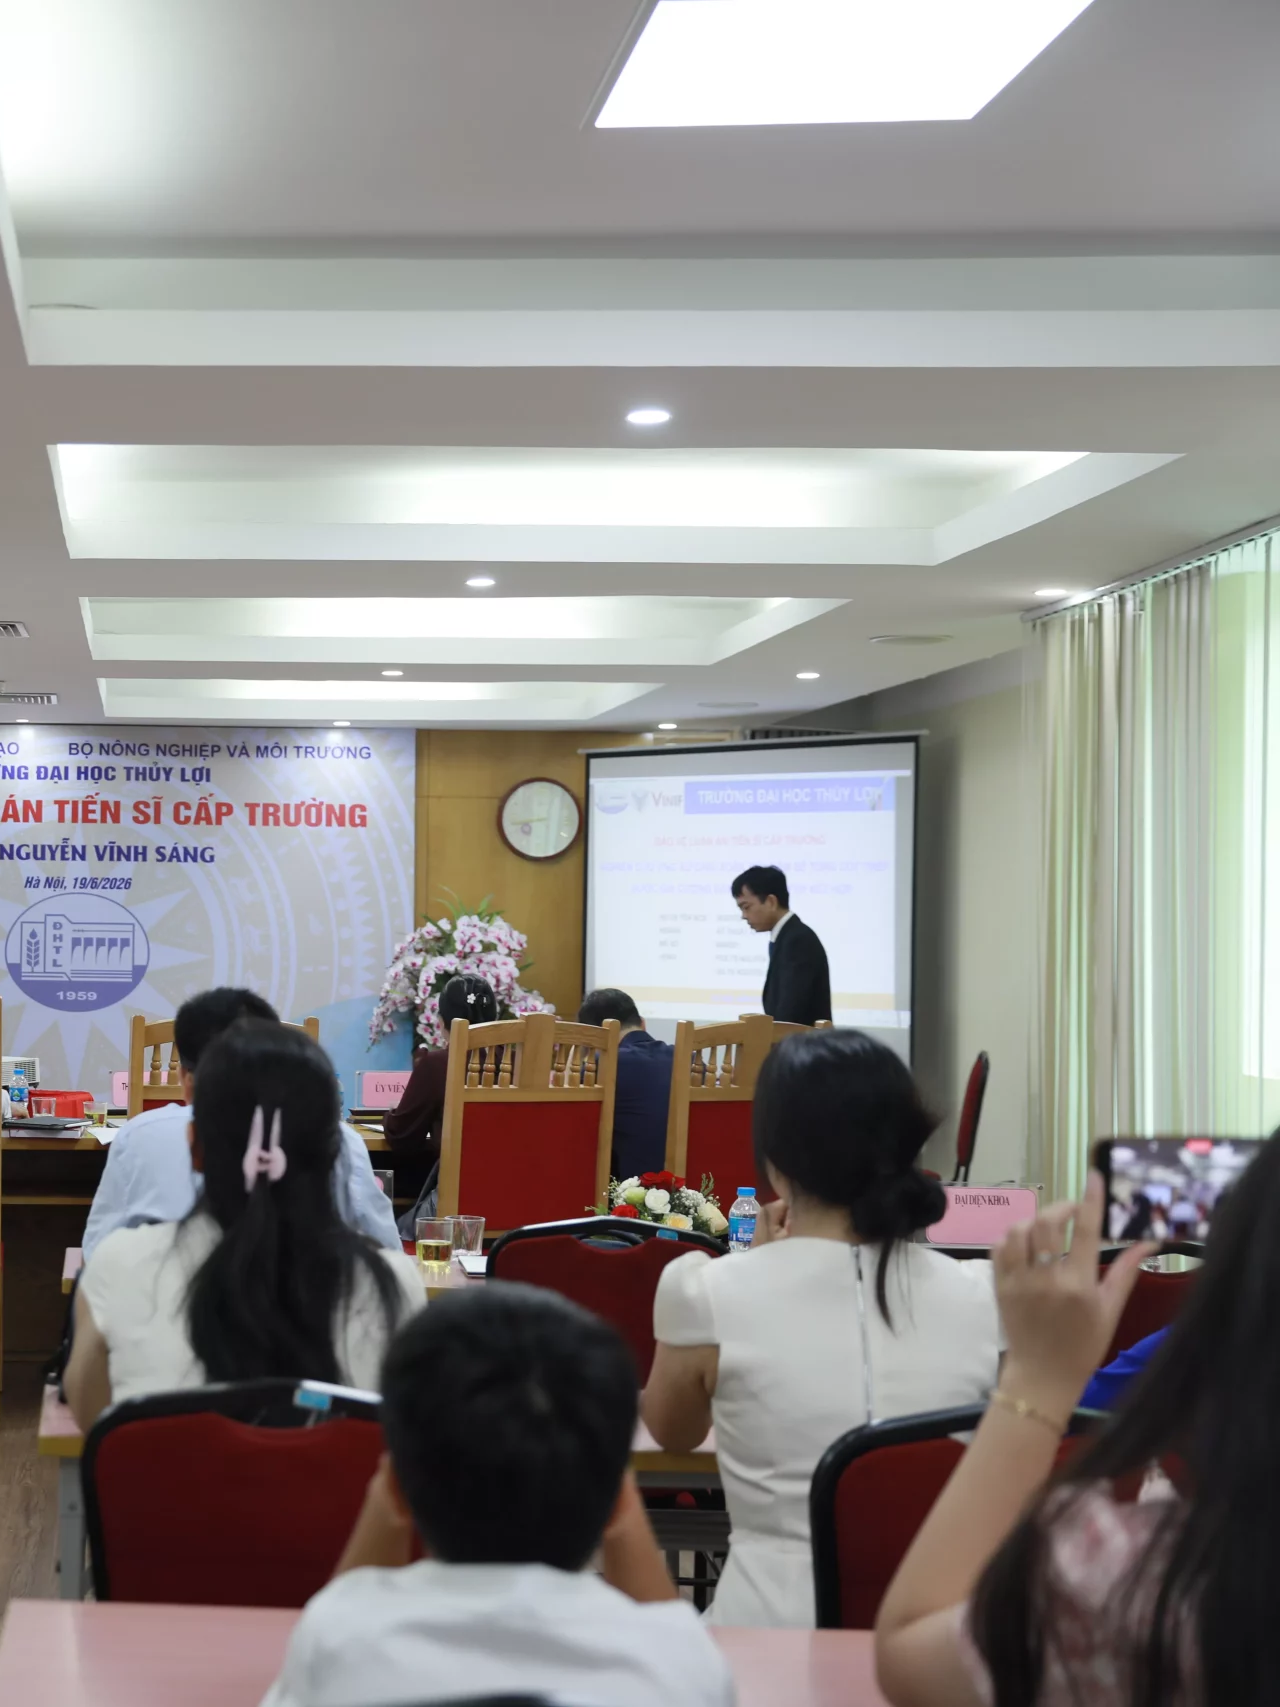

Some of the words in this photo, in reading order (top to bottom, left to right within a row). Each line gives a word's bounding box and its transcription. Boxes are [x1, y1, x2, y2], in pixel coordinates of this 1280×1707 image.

[68, 741, 93, 760] BỘ
[99, 740, 150, 757] NÔNG
[155, 742, 221, 761] NGHIỆP
[226, 741, 250, 758] VÀ
[256, 742, 288, 759] MÔI
[295, 744, 372, 760] TRƯỜNG
[35, 765, 69, 784] ĐẠI
[76, 765, 116, 784] HỌC
[123, 761, 175, 782] THỦY
[180, 766, 211, 786] LỢI
[697, 787, 753, 804] TRƯỜNG
[756, 788, 780, 805] ĐẠI
[782, 787, 812, 804] HỌC
[0, 794, 43, 823] ÁN
[54, 792, 121, 824] TIẾN
[132, 796, 162, 825] SĨ
[173, 793, 234, 826] CẤP
[244, 797, 368, 828] TRƯỜNG
[93, 841, 148, 862] VĨNH
[155, 842, 216, 863] SÁNG
[24, 876, 40, 889] Hà
[43, 876, 67, 892] Nội,
[72, 877, 132, 890] 19/6/2026
[56, 990, 98, 1001] 1959
[955, 1194, 968, 1207] ĐẠI
[969, 1194, 987, 1207] DIỆN
[988, 1195, 1010, 1206] KHOA
